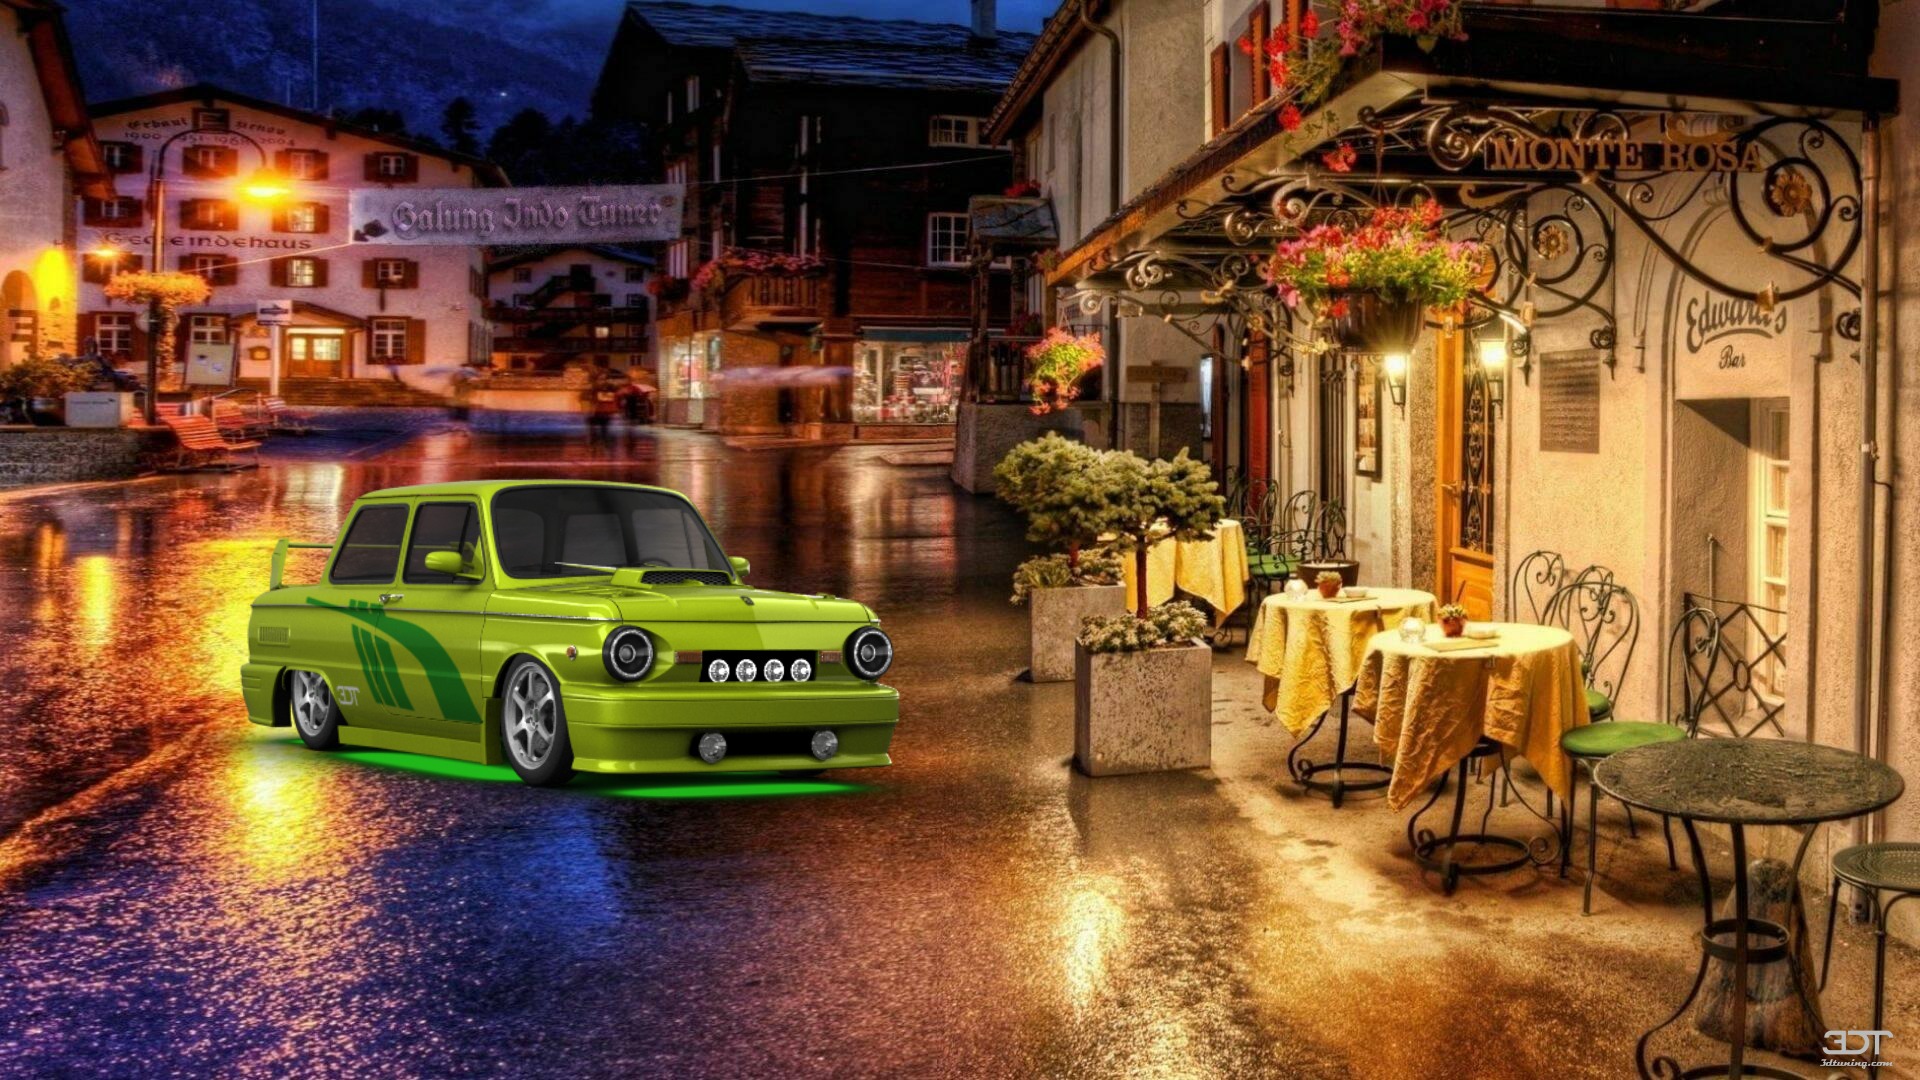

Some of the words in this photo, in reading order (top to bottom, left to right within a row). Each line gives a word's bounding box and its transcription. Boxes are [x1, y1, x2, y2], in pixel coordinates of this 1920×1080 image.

[1490, 136, 1645, 170] MONTE
[1660, 140, 1764, 172] ROSA
[1686, 290, 1787, 354] Edwars
[1718, 344, 1746, 370] Bar
[336, 685, 360, 707] 3DT
